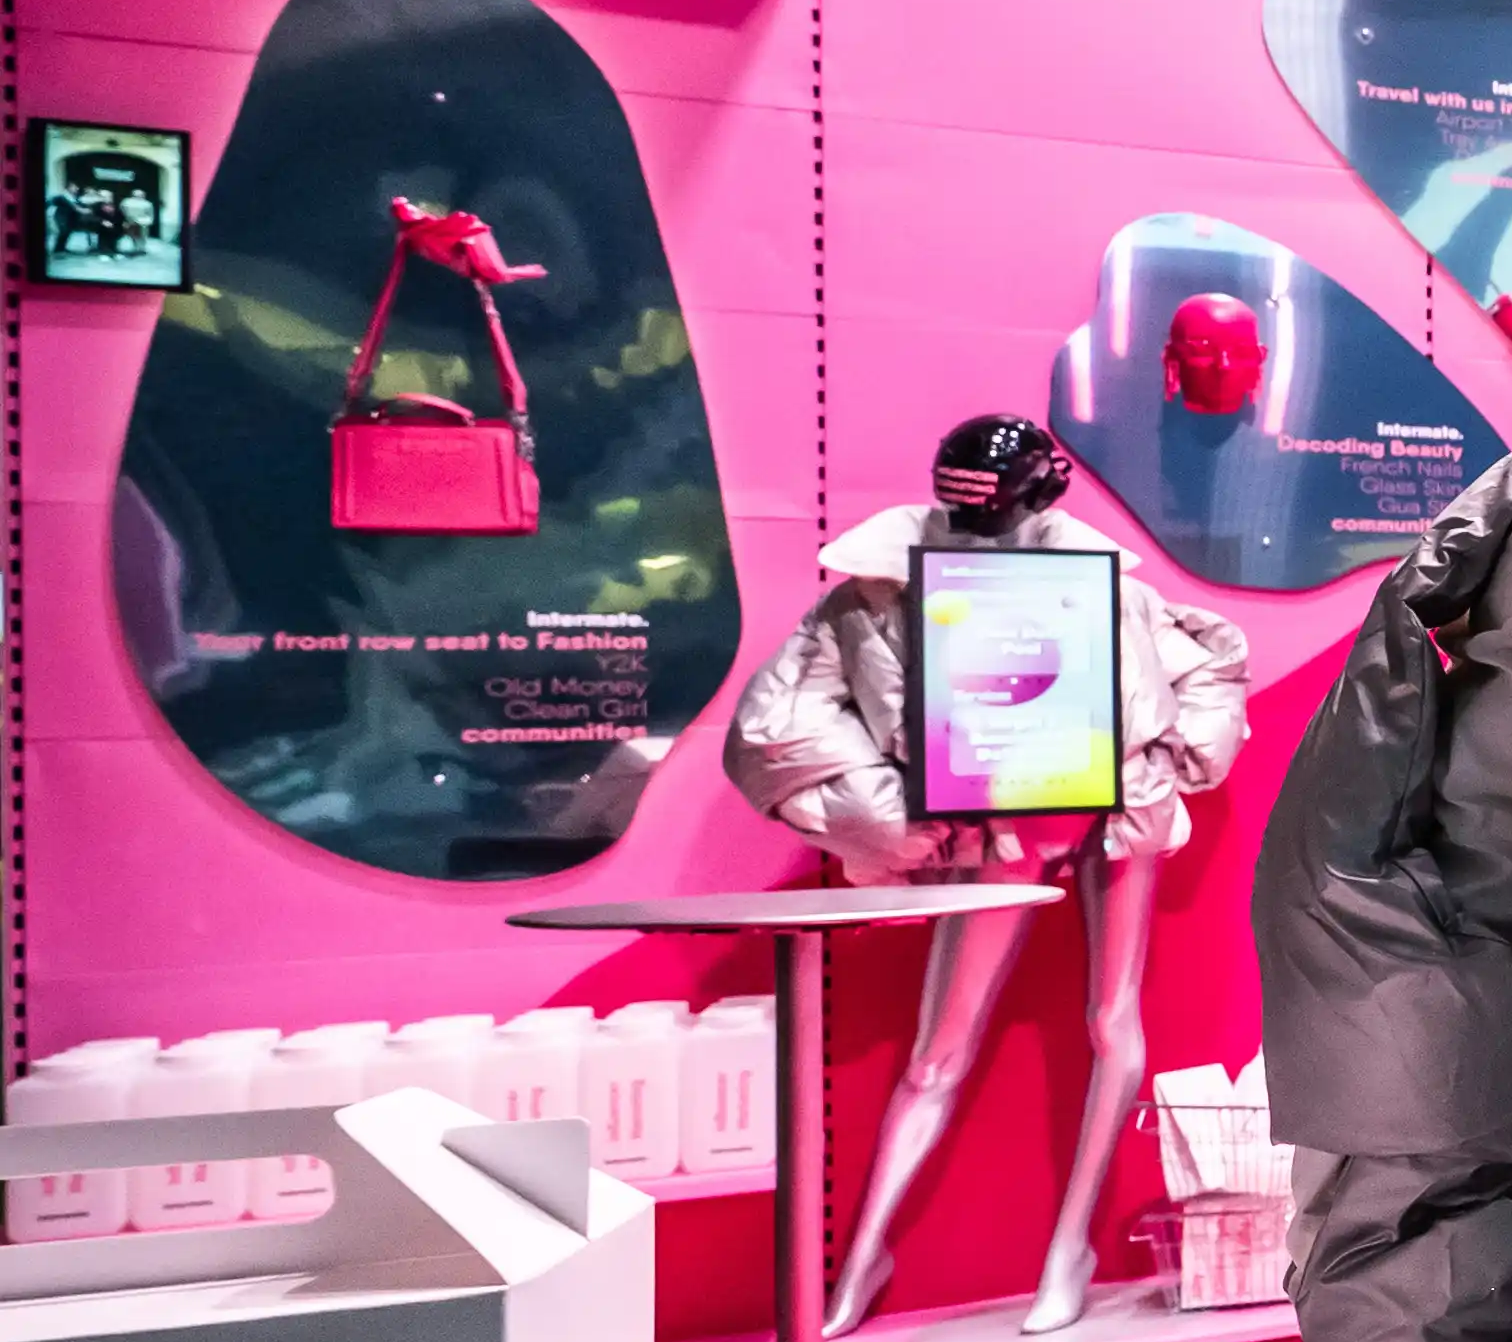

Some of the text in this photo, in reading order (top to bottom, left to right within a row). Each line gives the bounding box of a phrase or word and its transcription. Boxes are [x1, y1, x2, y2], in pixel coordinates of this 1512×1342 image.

[1357, 79, 1420, 103] Travel
[1424, 91, 1467, 110] with
[1471, 98, 1496, 113] us
[1277, 435, 1464, 462] Decoding Beauty
[1331, 517, 1432, 534] communit
[273, 632, 648, 651] front row seat to Fashion
[461, 724, 648, 744] communities
